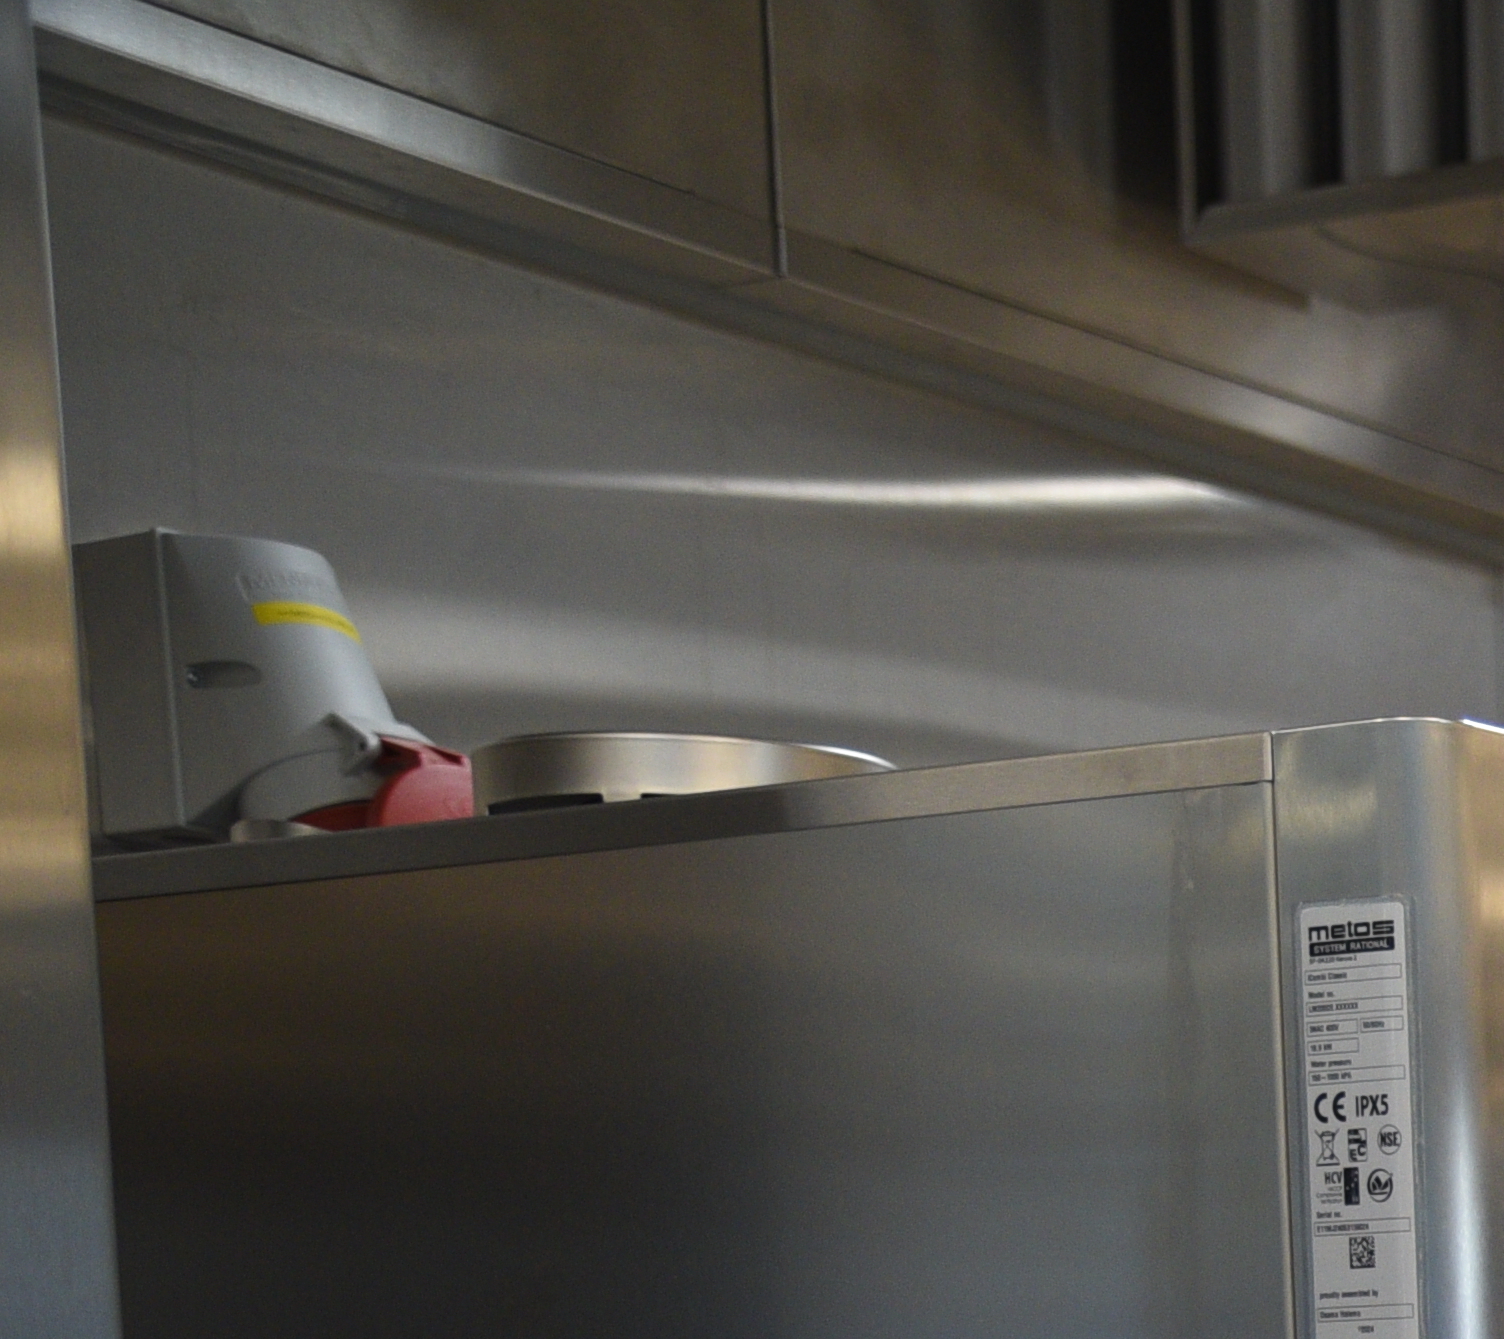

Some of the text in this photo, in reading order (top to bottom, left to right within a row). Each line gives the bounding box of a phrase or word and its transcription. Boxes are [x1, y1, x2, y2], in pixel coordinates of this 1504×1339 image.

[1307, 920, 1395, 942] metos
[1312, 938, 1390, 954] SYSTEM RATIONAL
[1355, 1093, 1390, 1118] IPX5
